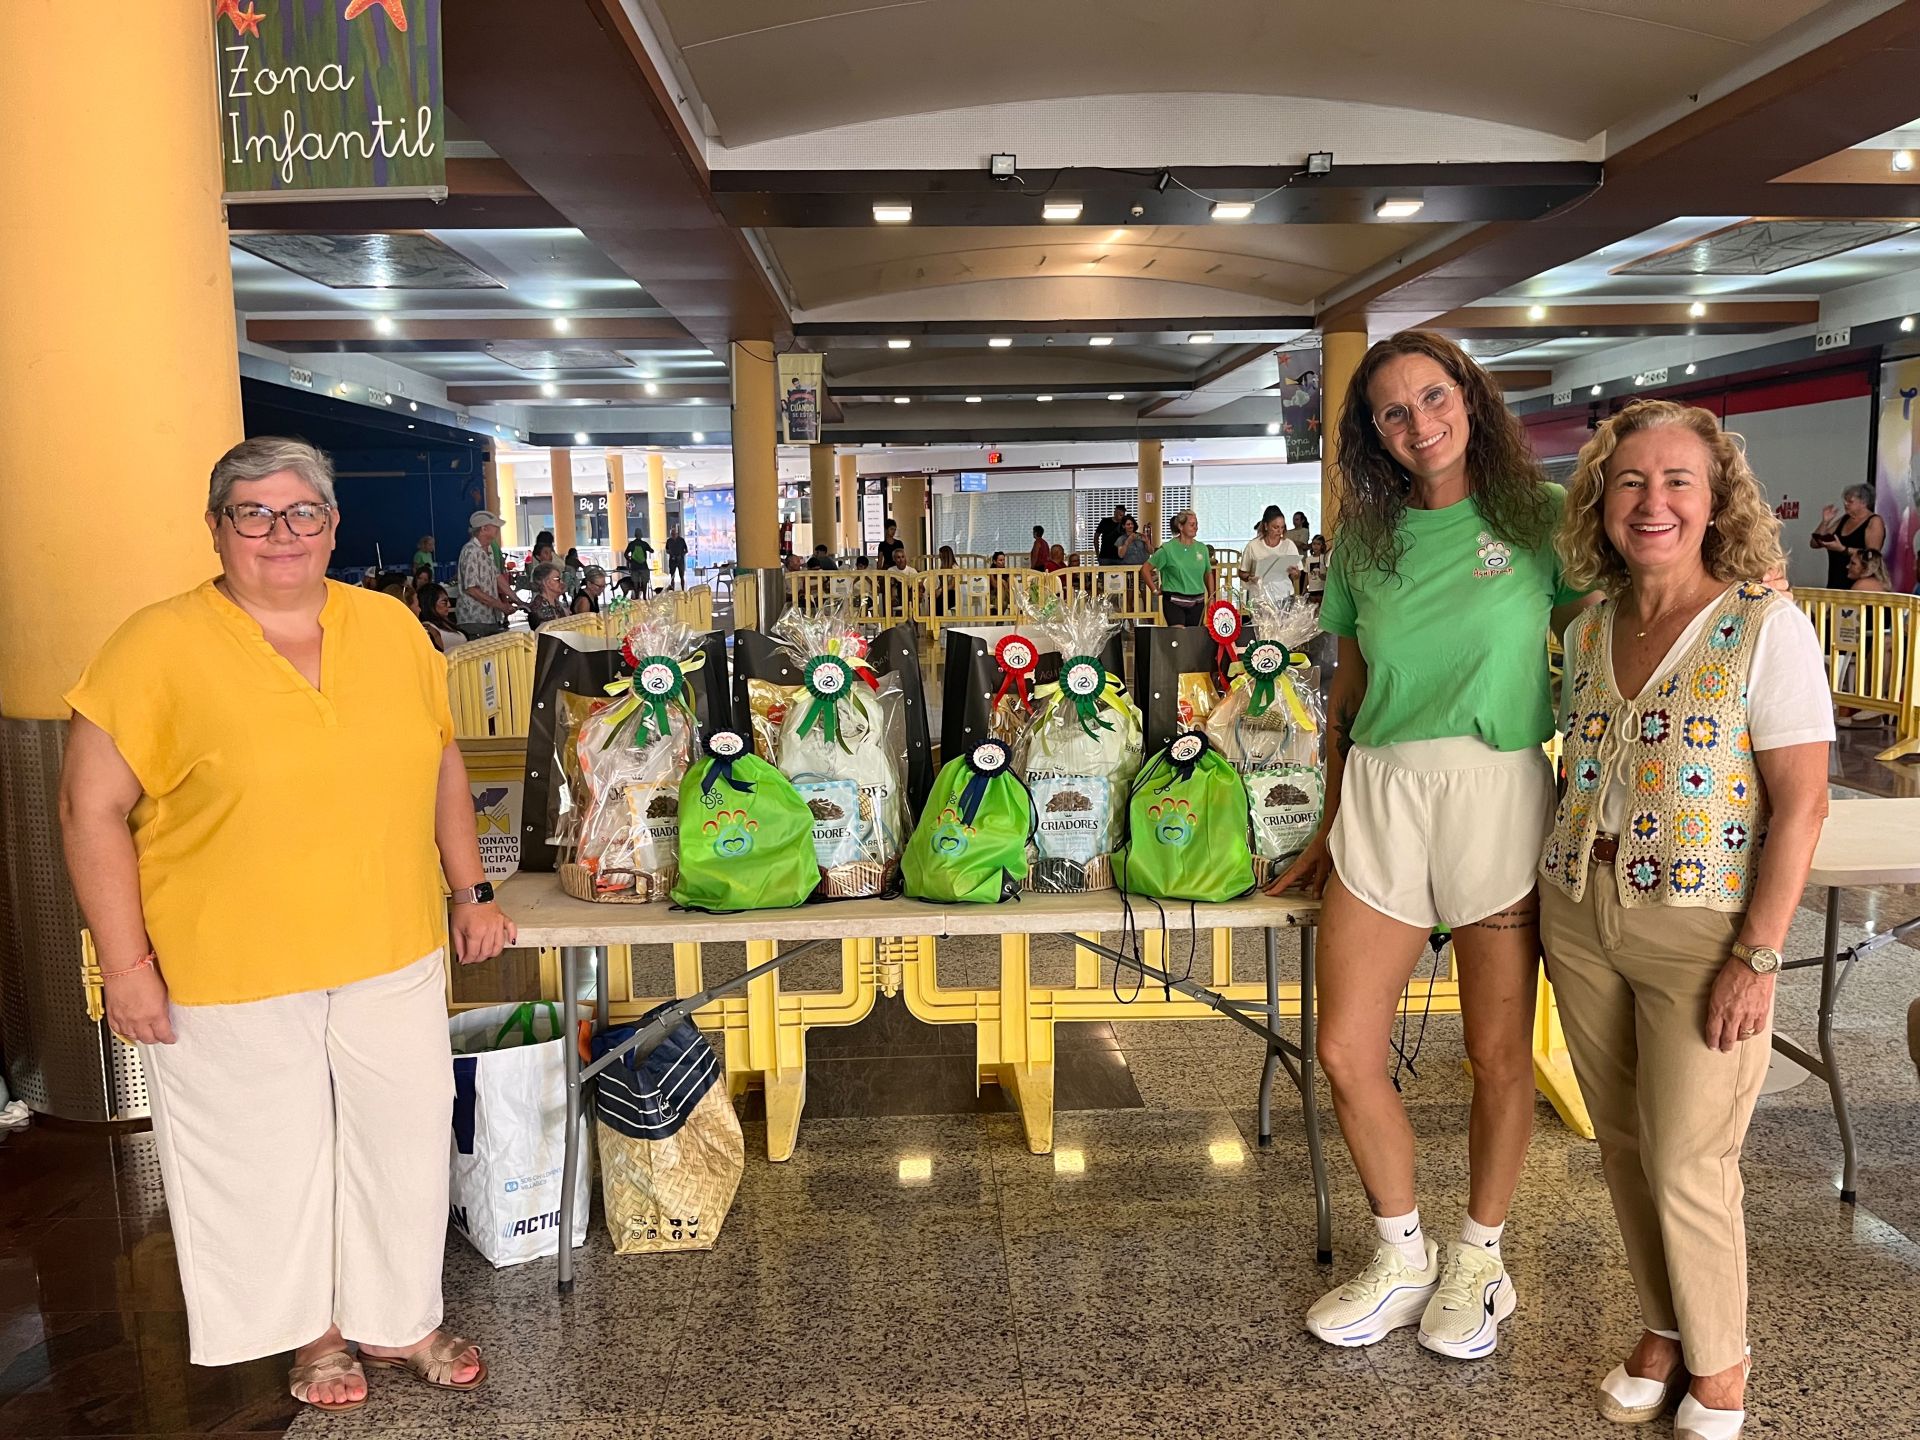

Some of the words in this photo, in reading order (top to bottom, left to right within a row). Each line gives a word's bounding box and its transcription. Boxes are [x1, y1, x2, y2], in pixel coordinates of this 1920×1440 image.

[225, 45, 355, 97] Zona
[228, 105, 435, 184] Infantil
[580, 498, 593, 512] Big
[1041, 819, 1099, 831] CRIADORES
[1263, 811, 1317, 826] CRIADORES
[650, 826, 679, 839] RIADO
[811, 827, 851, 840] ADORES
[477, 836, 519, 845] RONATO
[479, 845, 519, 855] ORTIVO
[480, 854, 520, 863] ICIPAL
[483, 866, 507, 874] uilas
[513, 1209, 561, 1237] ACTI
